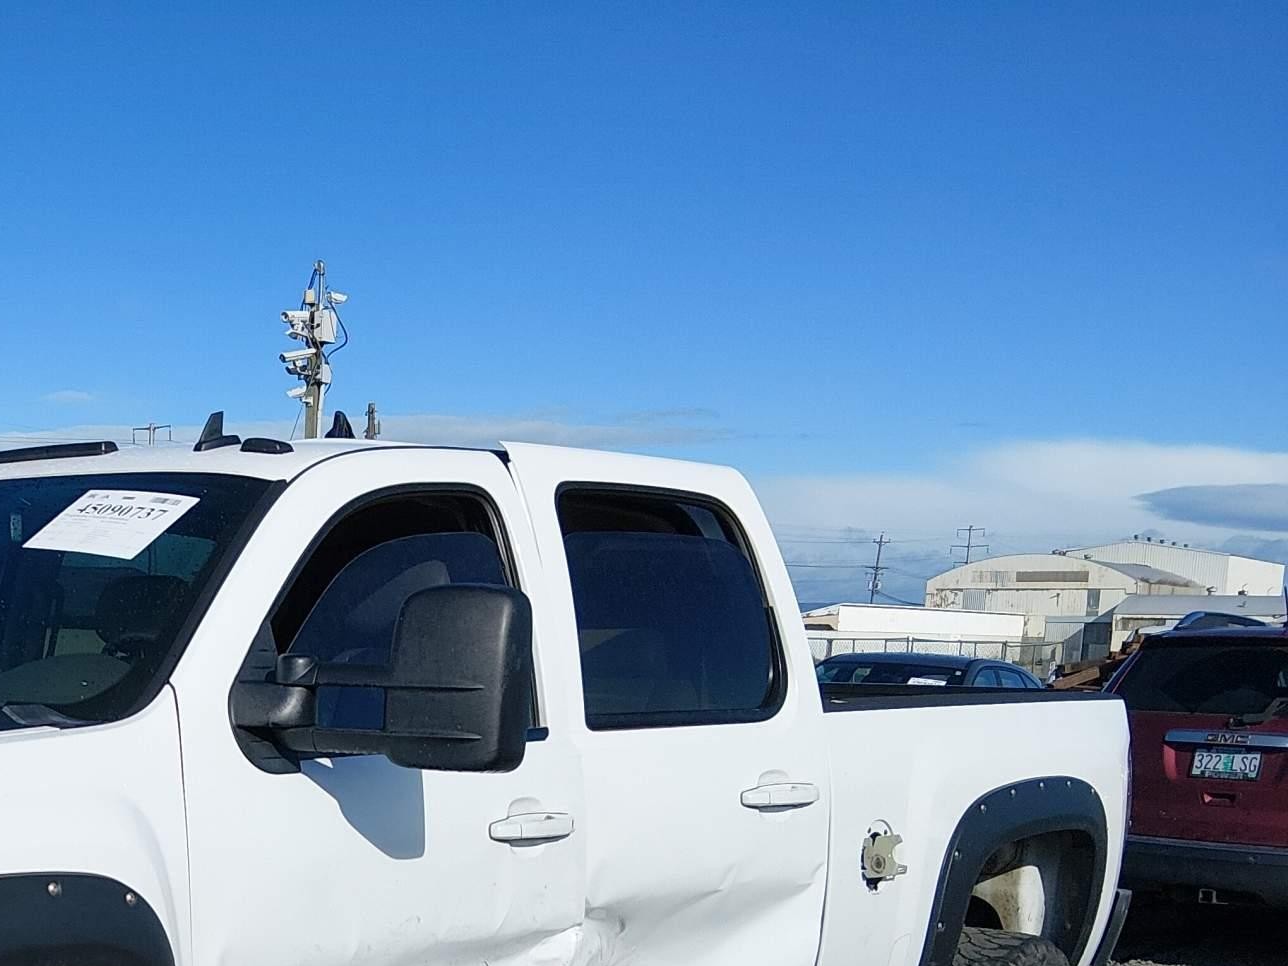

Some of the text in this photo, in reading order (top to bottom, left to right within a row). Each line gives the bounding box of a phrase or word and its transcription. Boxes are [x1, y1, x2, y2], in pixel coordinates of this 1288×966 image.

[77, 503, 169, 521] 45090737
[1206, 733, 1249, 744] GMC
[1194, 753, 1258, 773] 322 LSG
